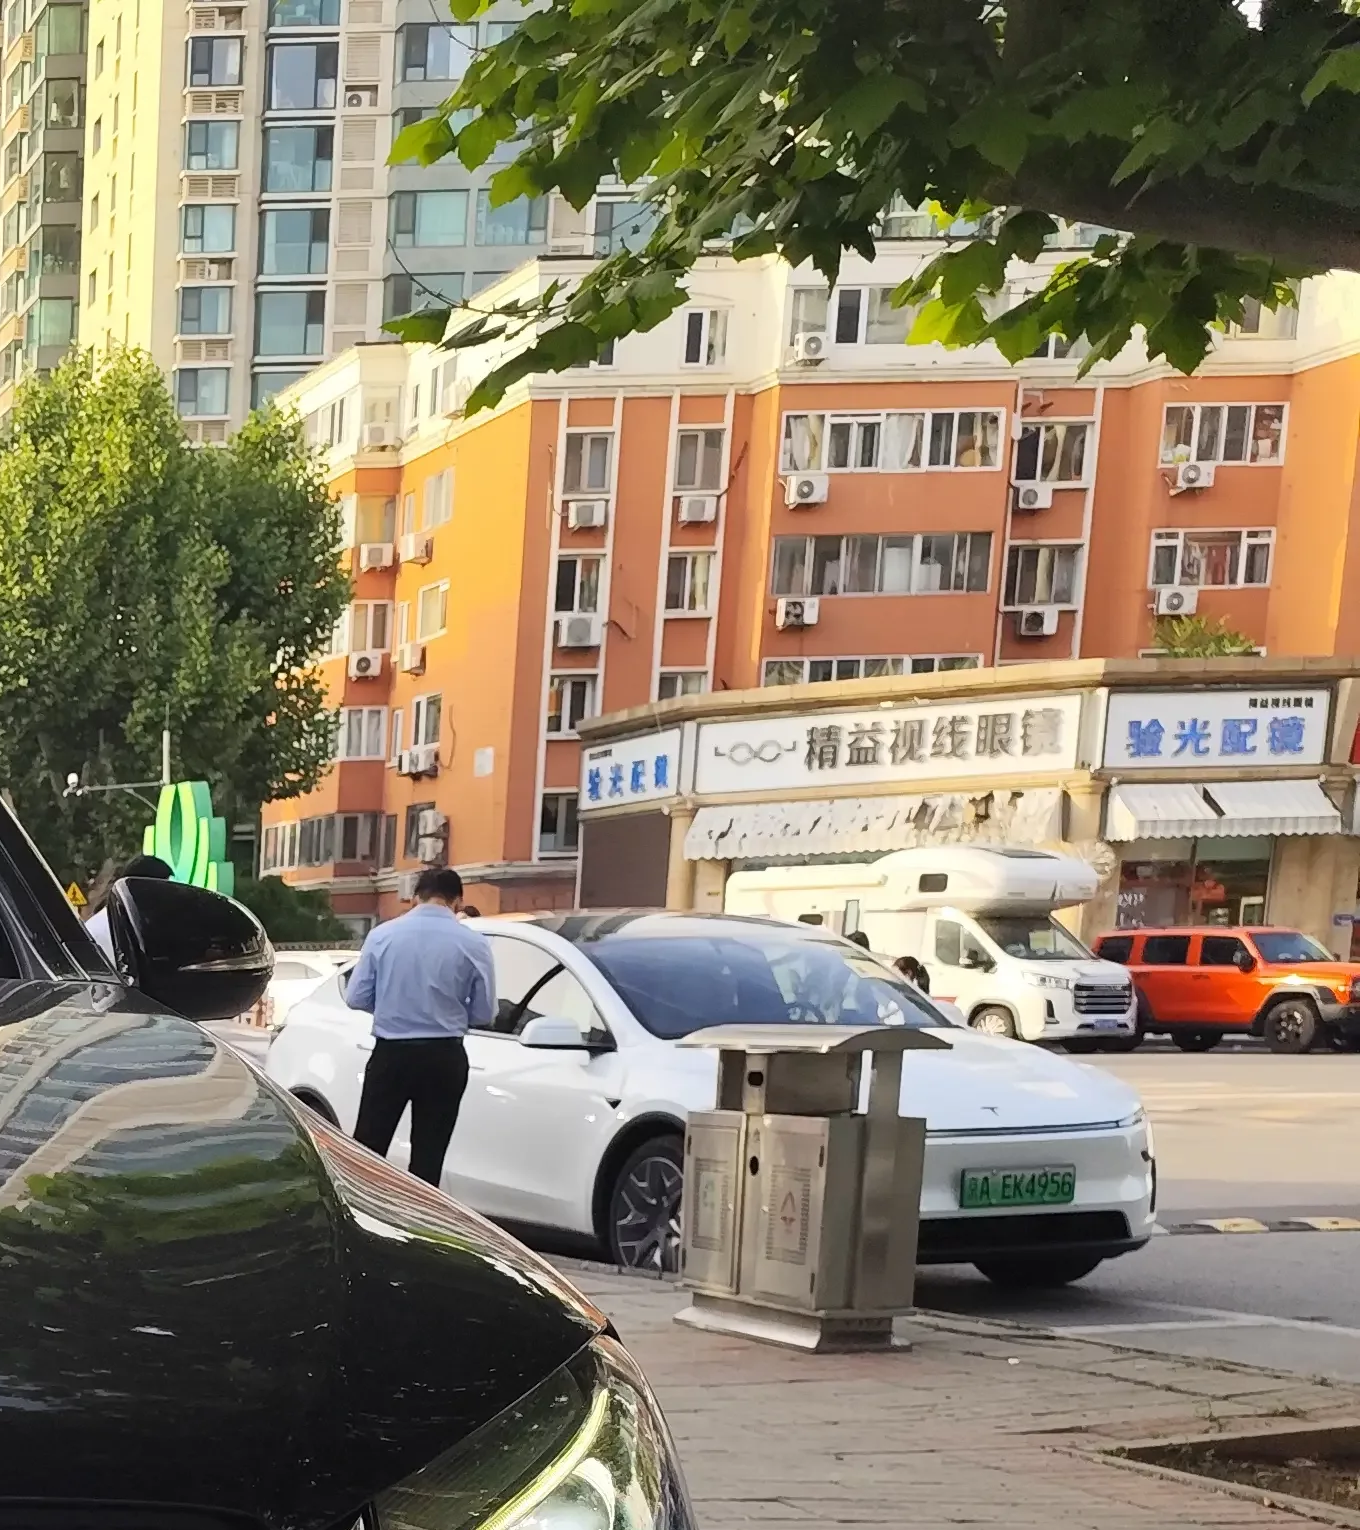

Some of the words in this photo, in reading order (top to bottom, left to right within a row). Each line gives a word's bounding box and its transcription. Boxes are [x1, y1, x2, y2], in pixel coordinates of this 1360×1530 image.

[804, 707, 1065, 772] 精益视线眼镜
[1125, 715, 1306, 758] 验光配镜
[1001, 1171, 1073, 1200] EK4956
